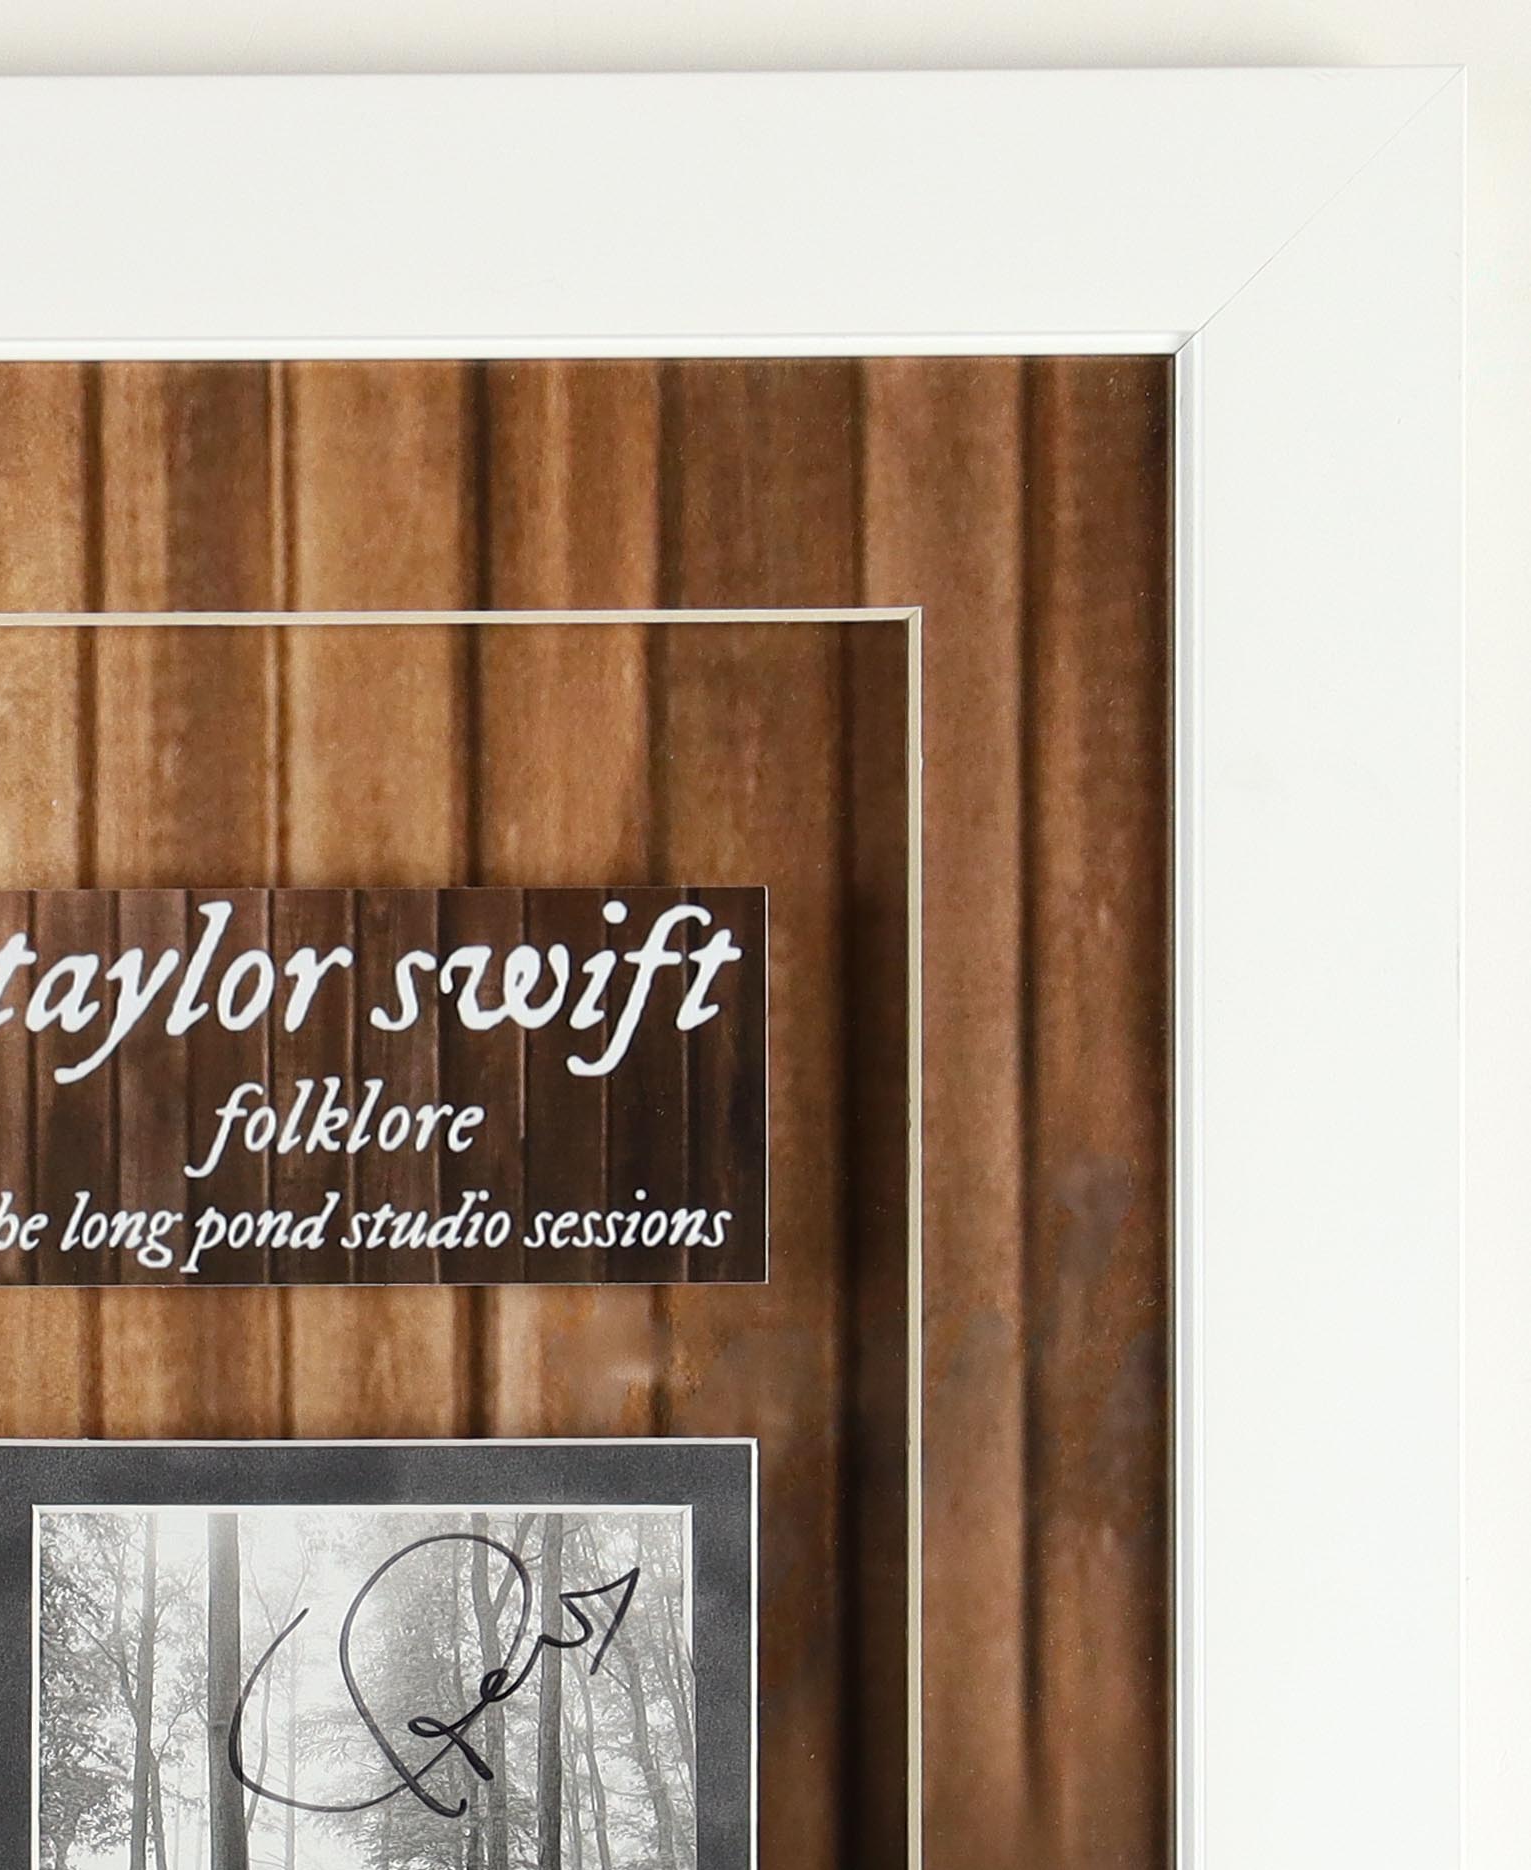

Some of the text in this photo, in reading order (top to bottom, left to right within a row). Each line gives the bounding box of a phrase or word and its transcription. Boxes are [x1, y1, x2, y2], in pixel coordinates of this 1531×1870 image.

[371, 901, 742, 1076] swift
[184, 1078, 485, 1178] folklore
[60, 1192, 183, 1268] long
[180, 1192, 340, 1273] pond
[341, 1190, 511, 1249] studio
[524, 1190, 733, 1249] sessions
